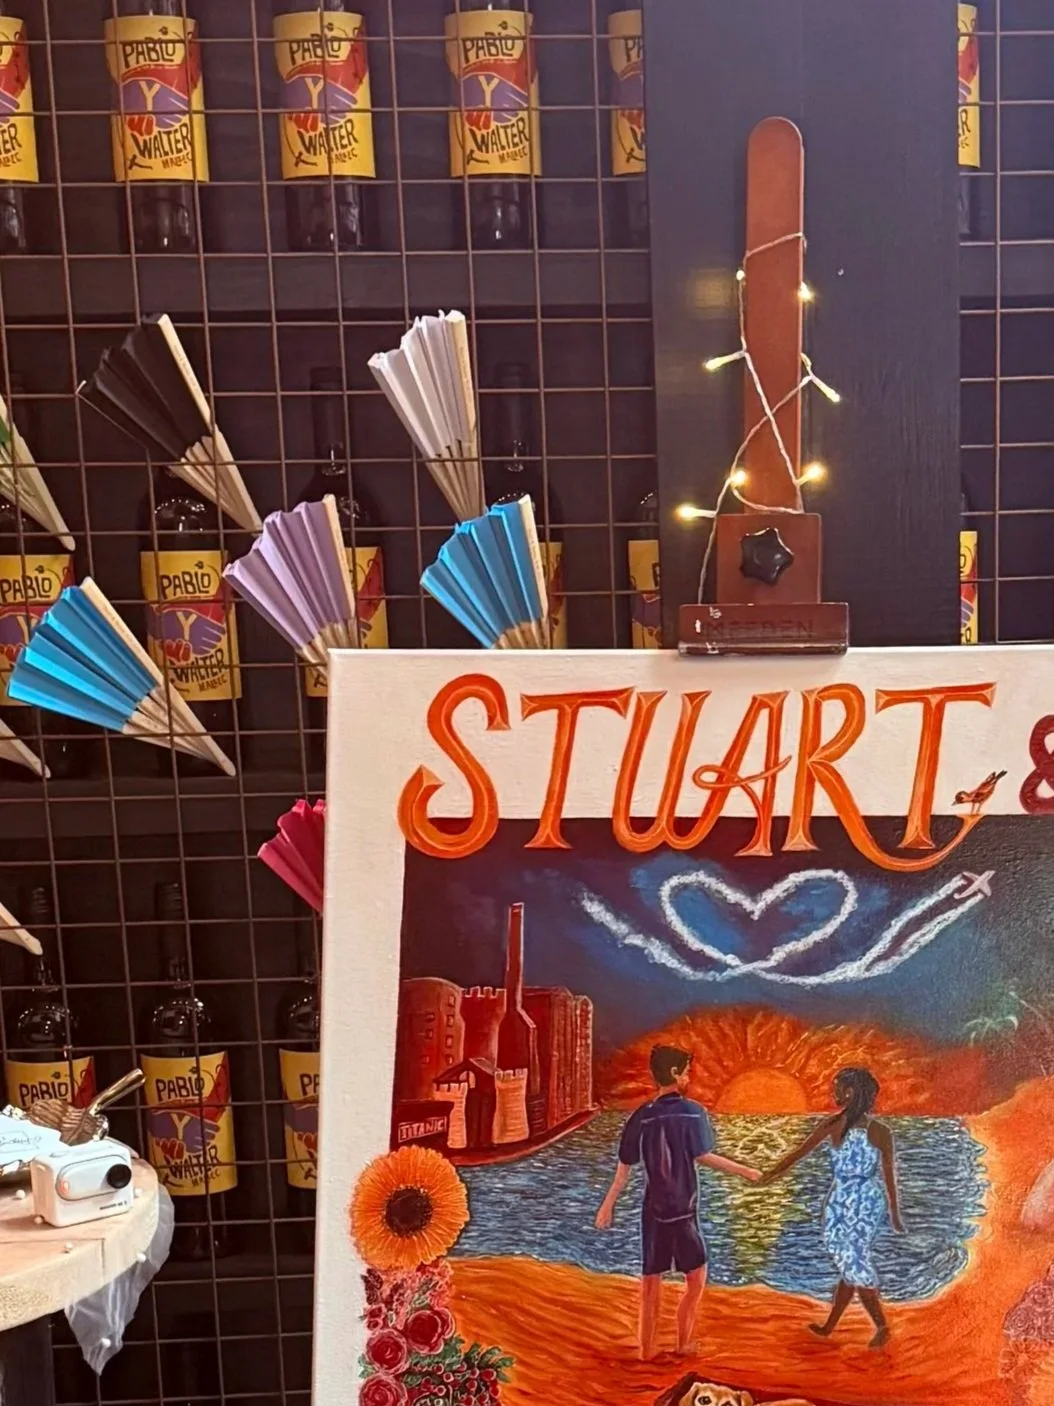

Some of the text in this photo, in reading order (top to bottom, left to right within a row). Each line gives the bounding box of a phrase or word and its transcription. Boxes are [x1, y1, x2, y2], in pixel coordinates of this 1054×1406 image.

[122, 37, 178, 69] PABLO
[289, 33, 342, 66] PABLO
[462, 31, 516, 64] PABLO
[131, 123, 192, 160] WALTER
[469, 117, 530, 154] WALTER
[0, 574, 53, 601] PABLO
[160, 571, 211, 601] PABLO
[171, 648, 226, 683] WALTER
[397, 674, 997, 872] STUART
[20, 1081, 69, 1107] PABLO
[156, 1076, 206, 1102] PABLO
[401, 1120, 446, 1139] TITANIC
[167, 1144, 219, 1179] WALTR
